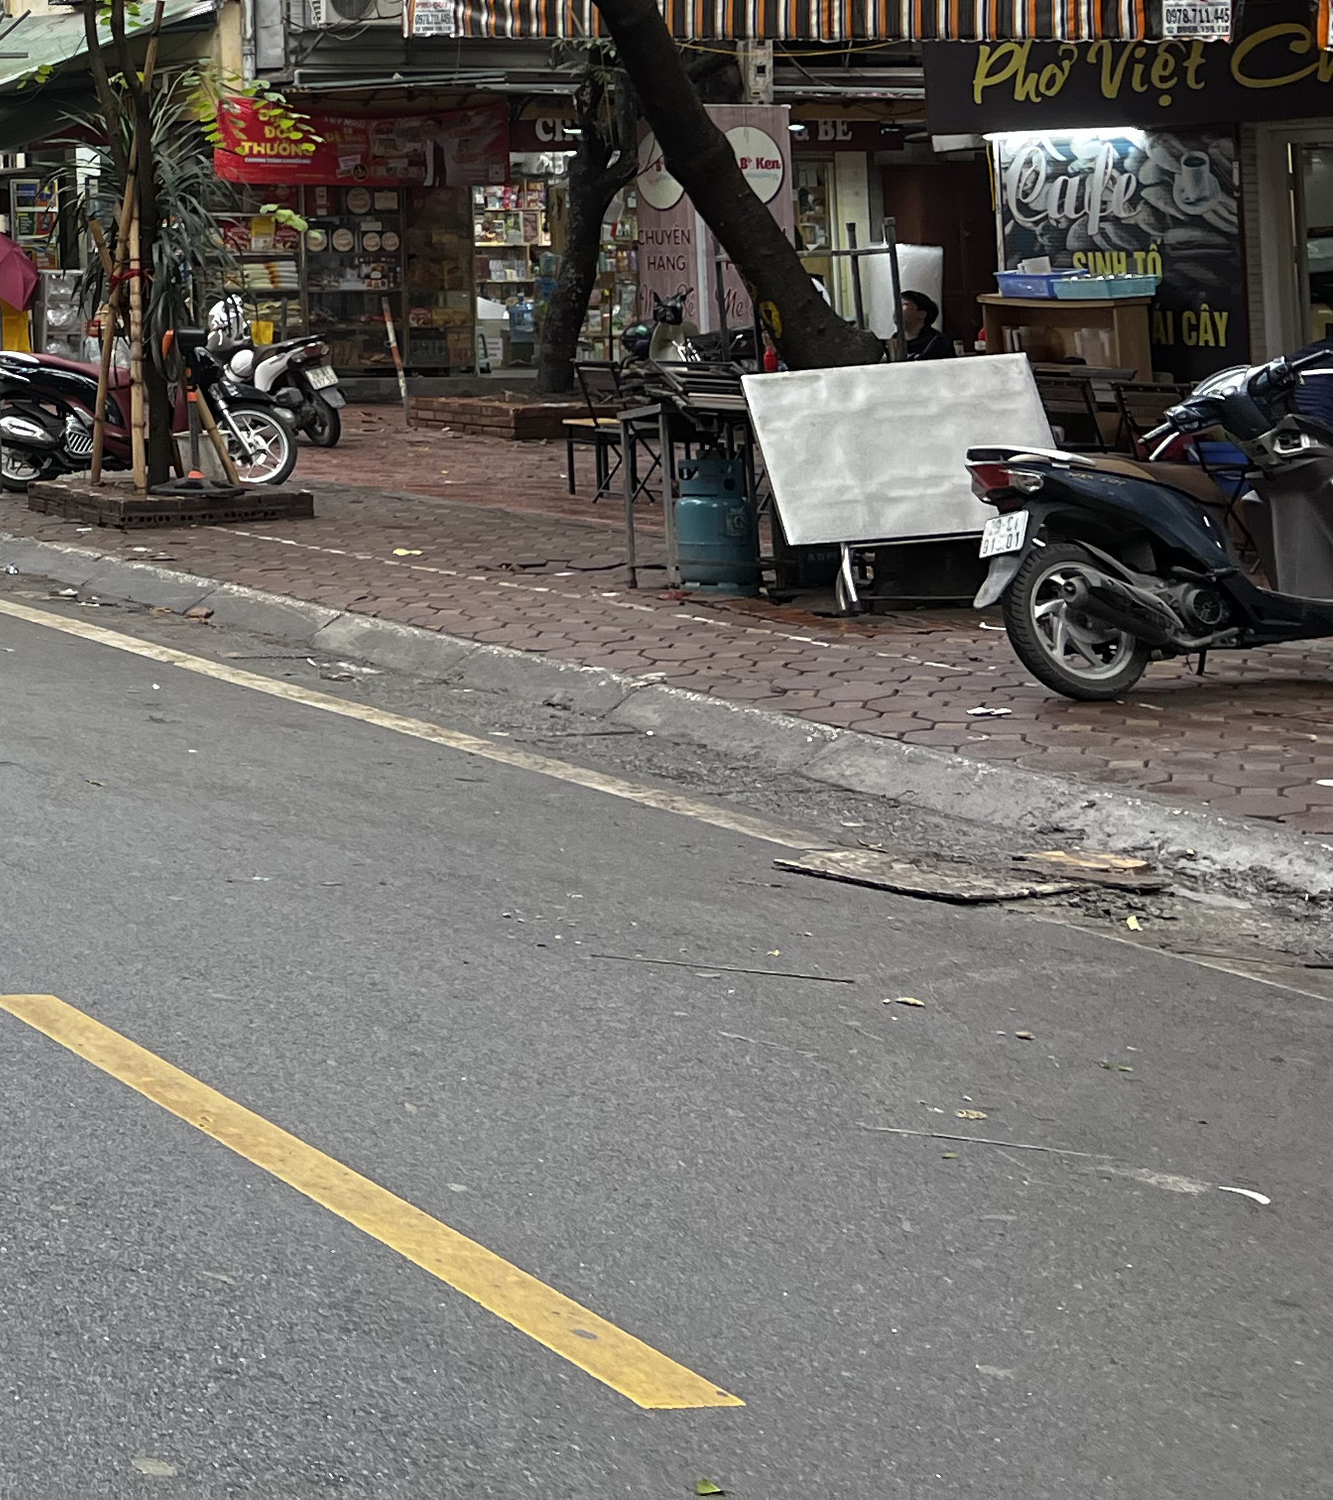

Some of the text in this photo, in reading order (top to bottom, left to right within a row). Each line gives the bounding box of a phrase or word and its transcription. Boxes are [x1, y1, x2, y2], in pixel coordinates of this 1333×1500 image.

[973, 41, 1077, 104] Phở
[1086, 41, 1206, 107] Việt
[756, 157, 781, 170] Ken
[639, 224, 691, 246] CHUYÊN
[1182, 303, 1229, 347] CÂY
